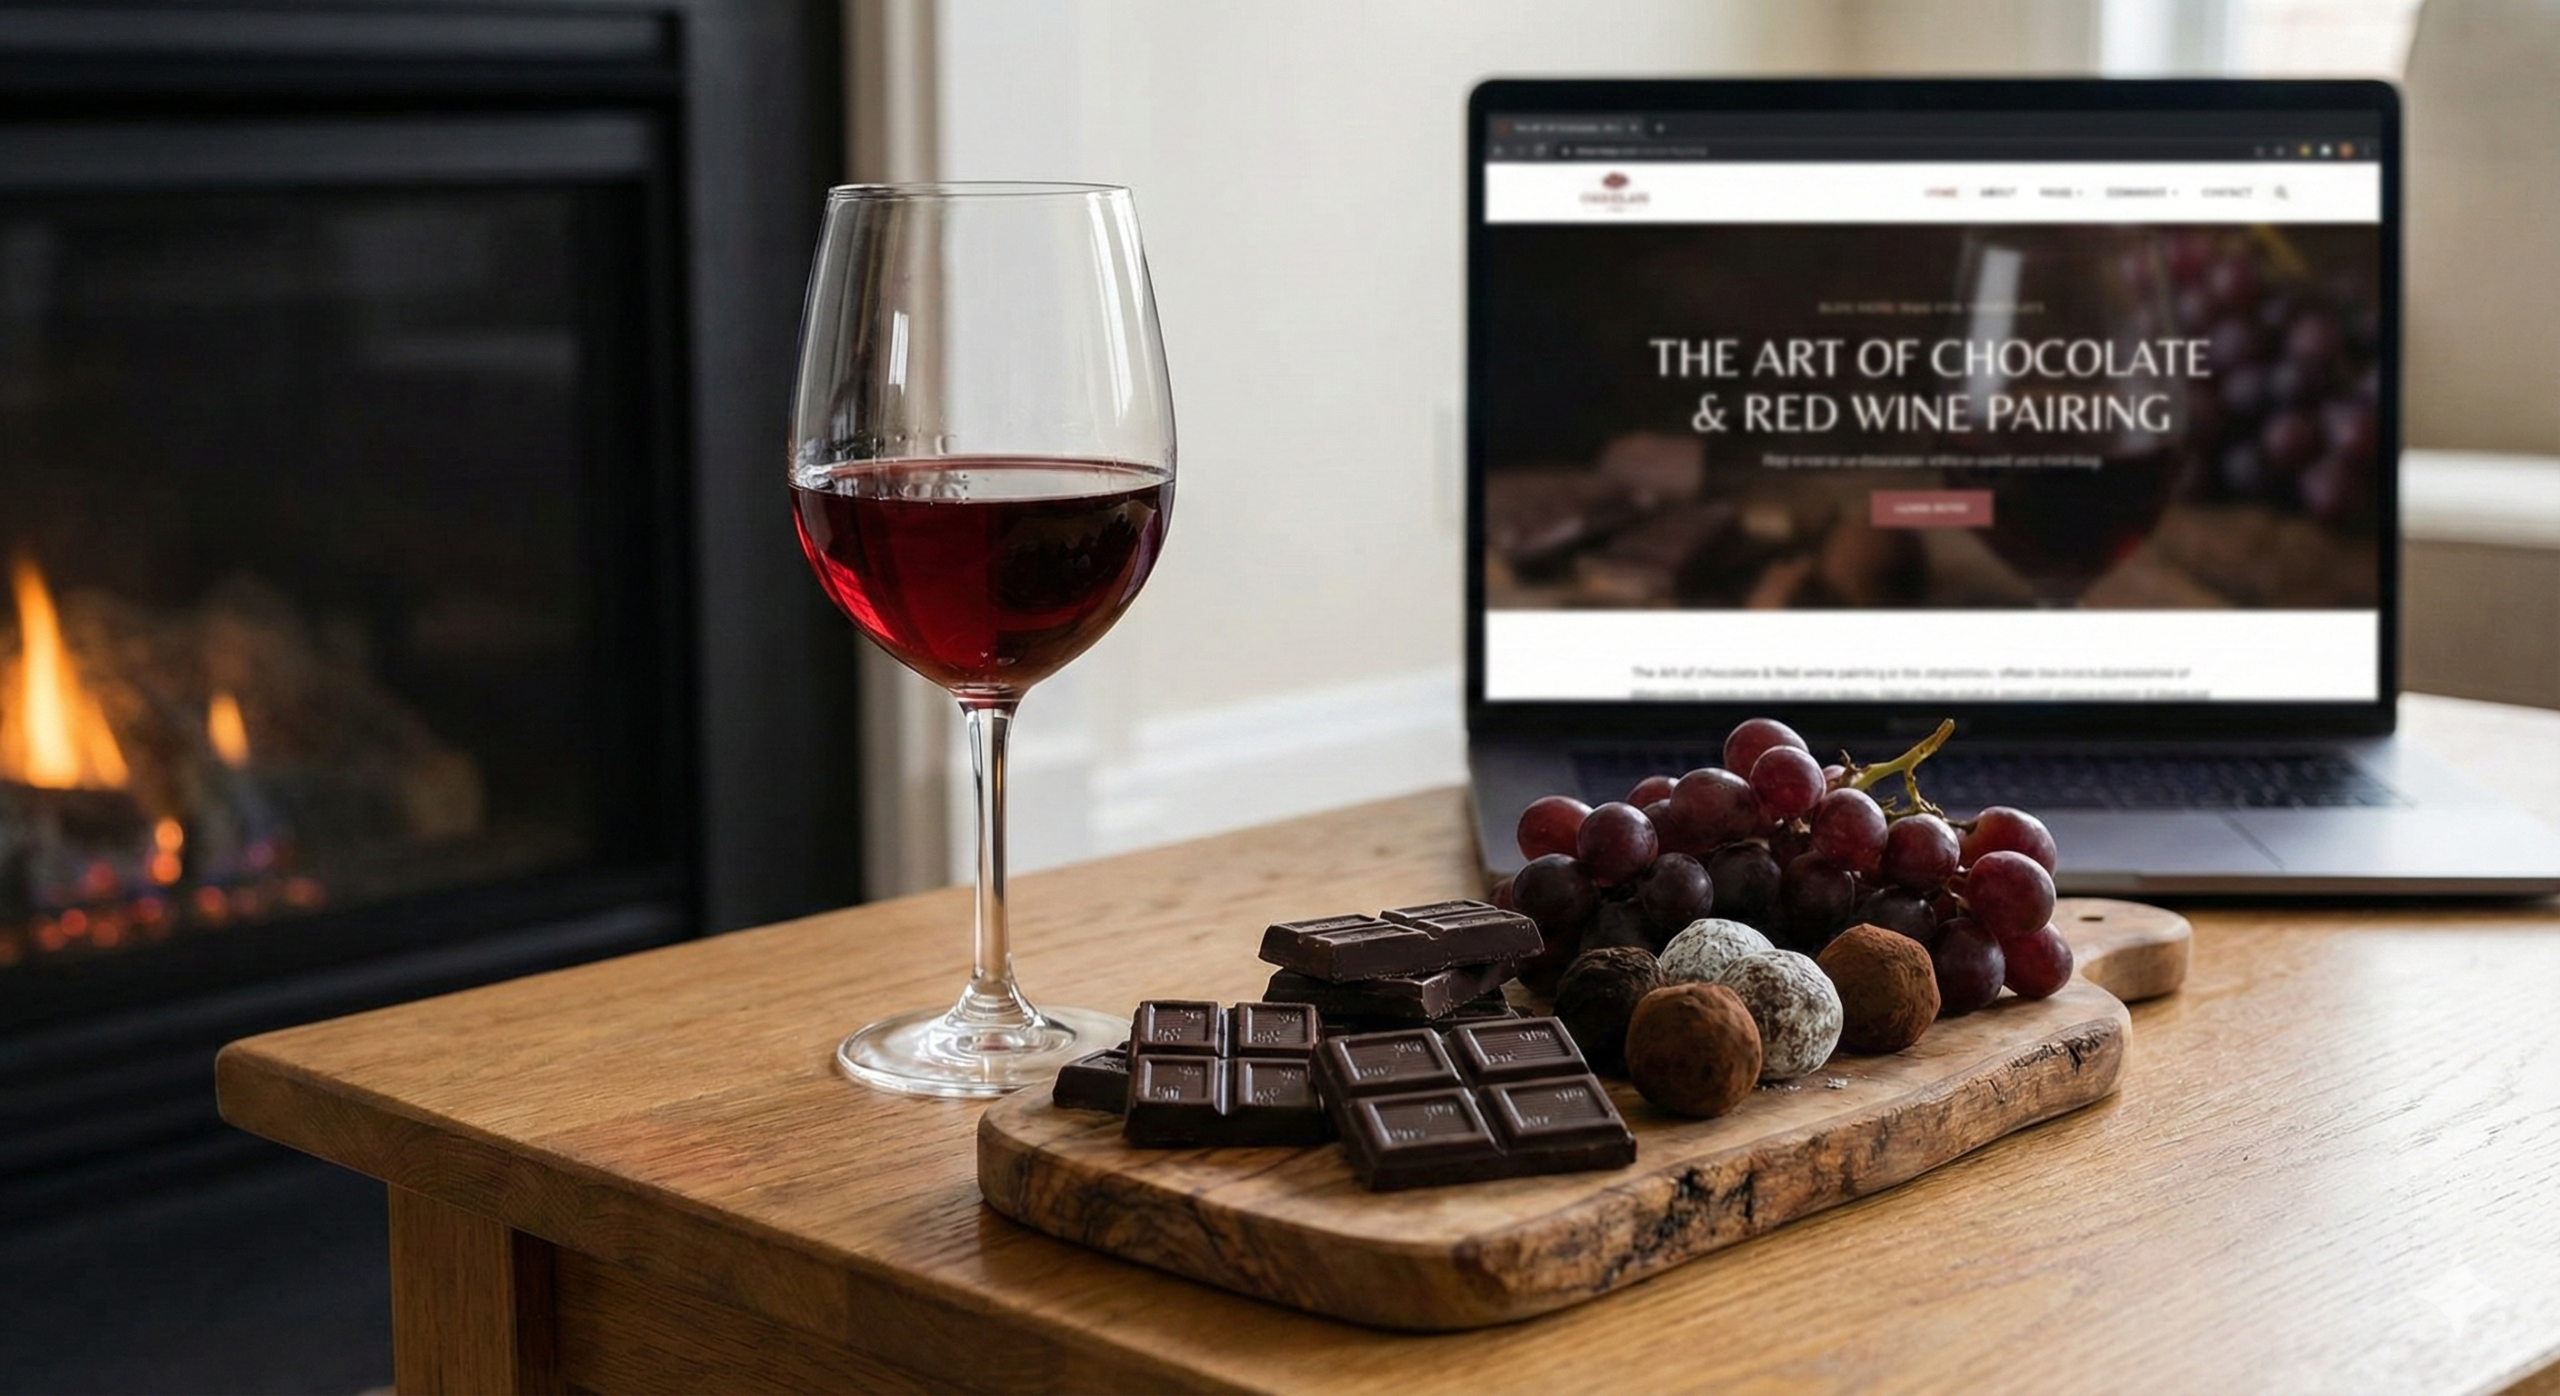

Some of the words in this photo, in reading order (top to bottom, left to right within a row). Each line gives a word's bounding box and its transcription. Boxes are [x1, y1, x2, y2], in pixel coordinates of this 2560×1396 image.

[1650, 338, 1739, 378] THE
[1753, 338, 1844, 378] ART
[1857, 338, 1920, 378] OF
[1930, 338, 2211, 378] CHOCOLATE
[1691, 393, 1727, 433] &
[1744, 393, 1838, 433] RED
[1850, 393, 1971, 433] WINE
[1987, 393, 2171, 433] PAIRING
